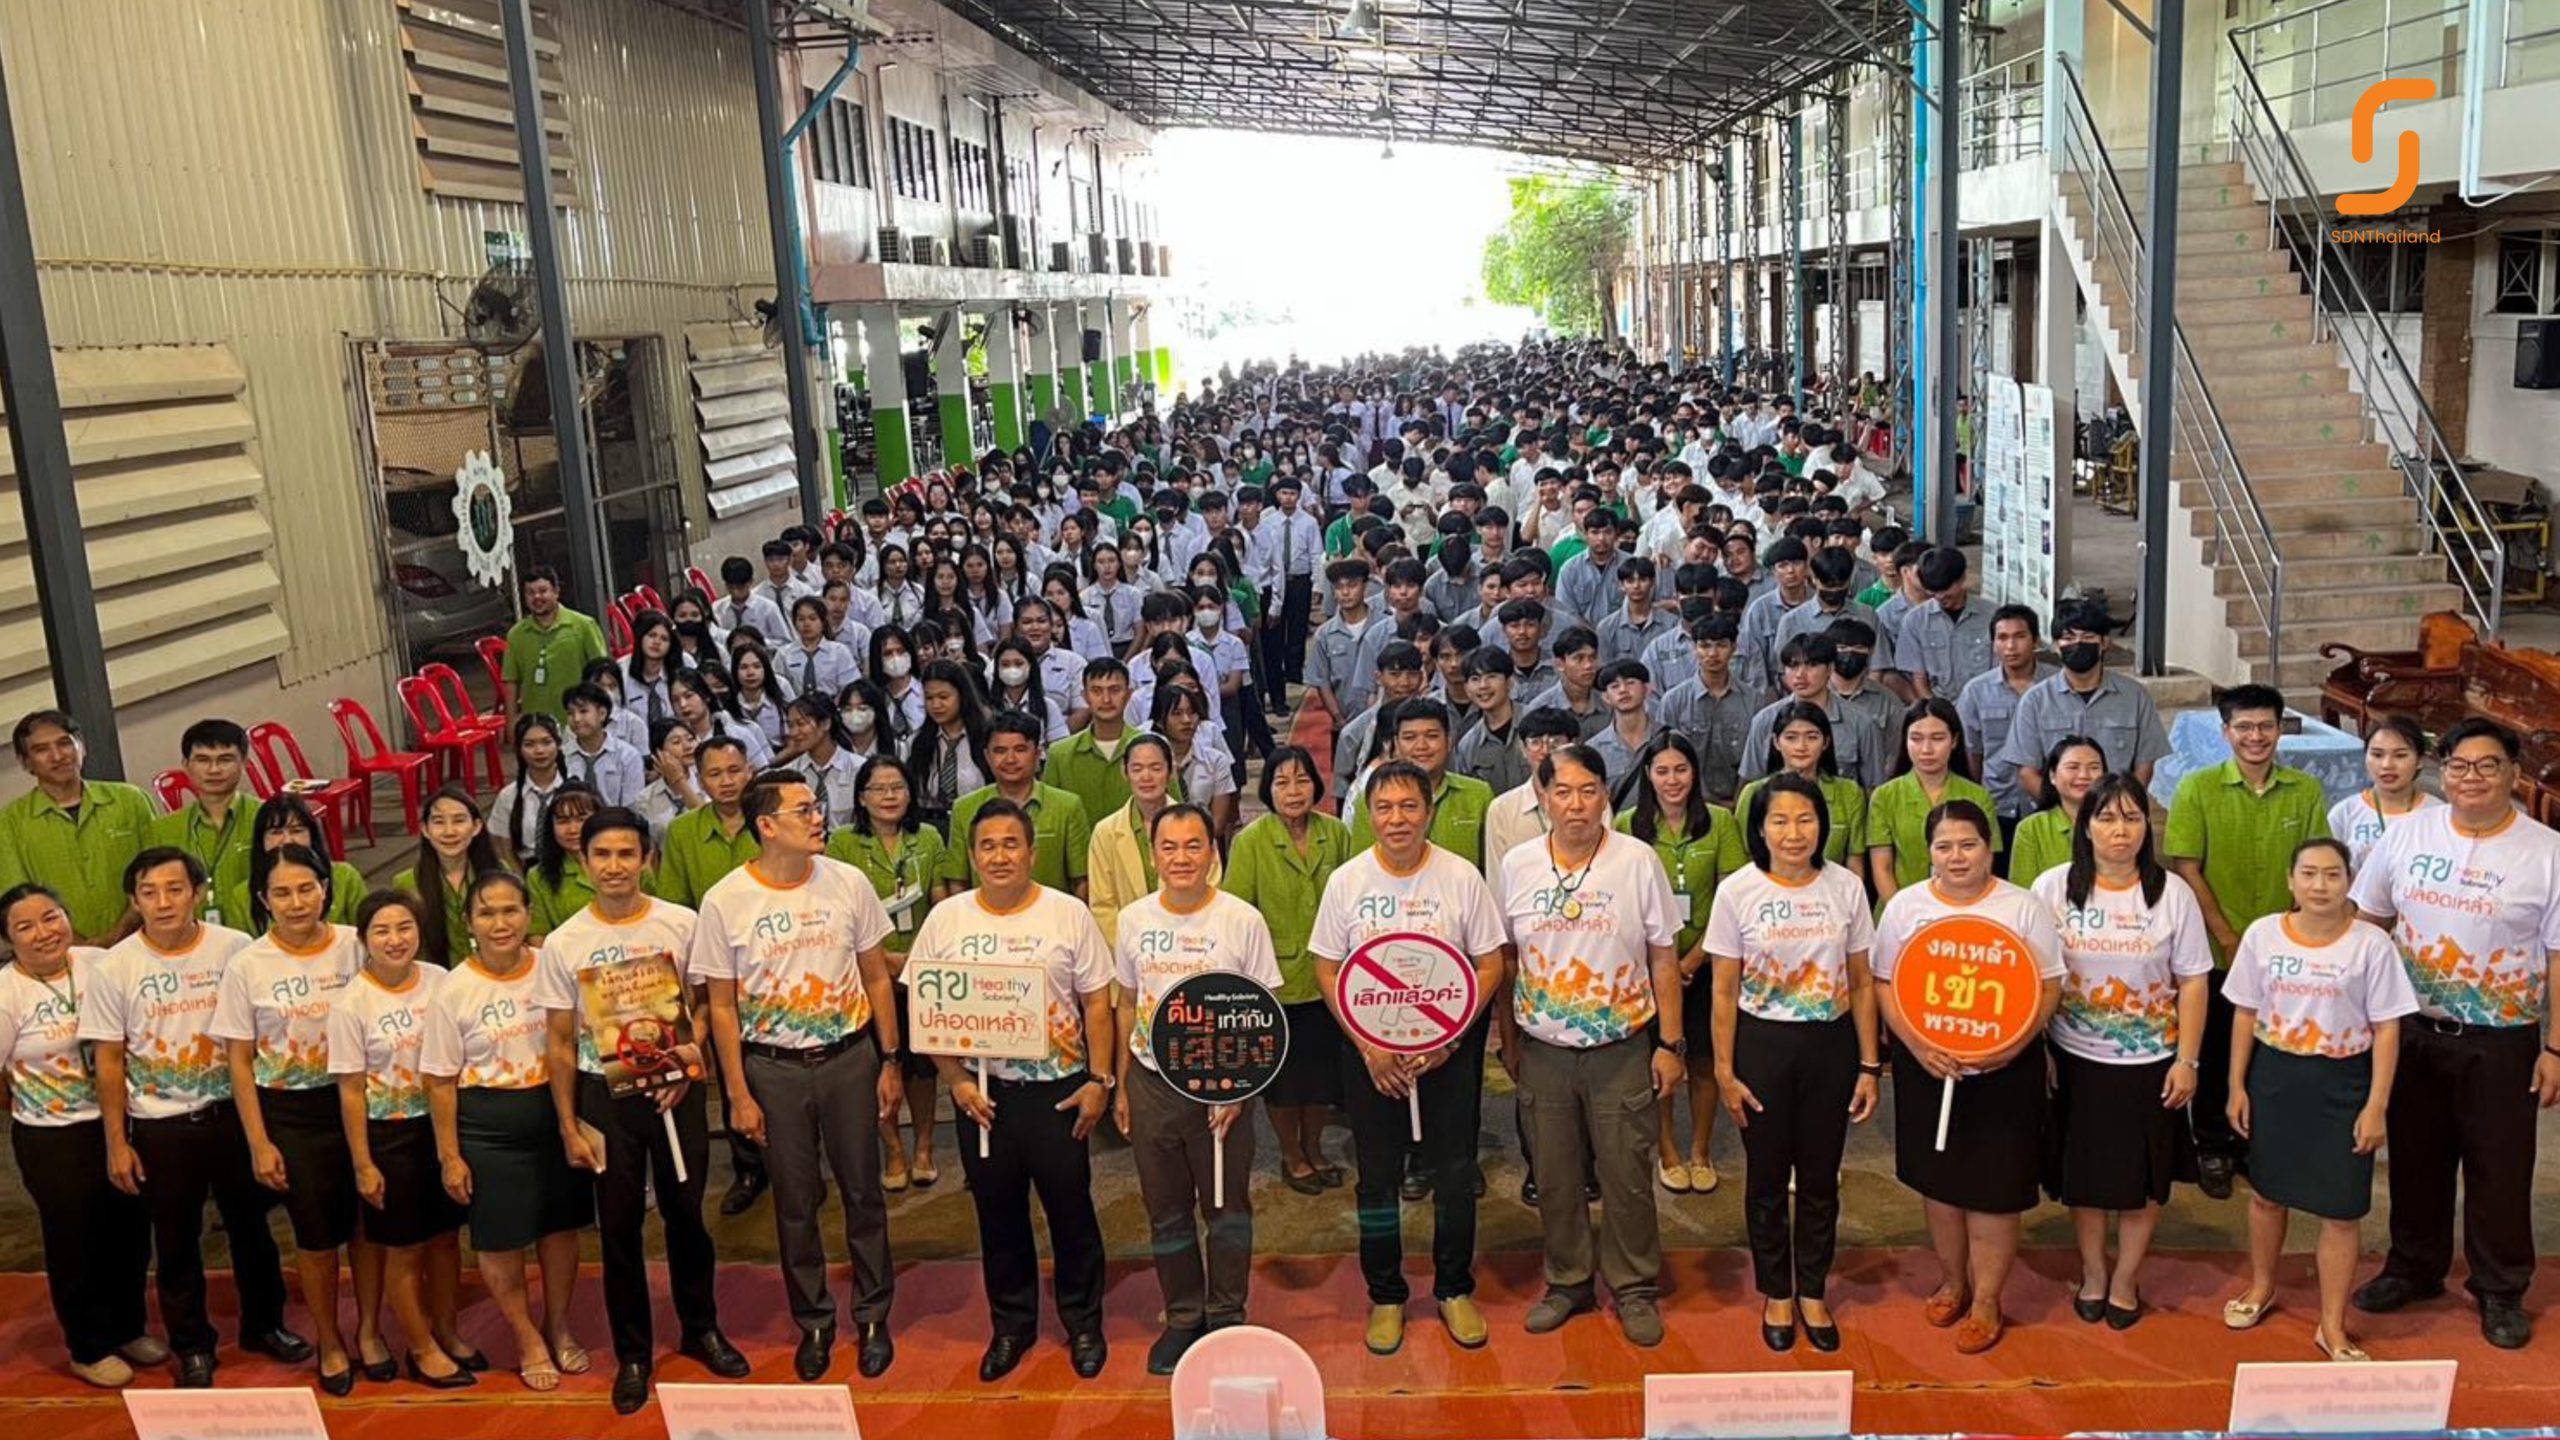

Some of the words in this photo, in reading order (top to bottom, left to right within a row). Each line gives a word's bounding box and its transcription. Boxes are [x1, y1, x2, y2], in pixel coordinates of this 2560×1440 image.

[2409, 854, 2454, 887] สุข
[1359, 895, 1396, 927] สุข
[1759, 900, 1792, 928] สุข
[2403, 885, 2494, 916] ปลอดเหล้า
[755, 911, 792, 943] สุข
[2066, 906, 2105, 937] สุข
[961, 933, 998, 961] สุข
[1140, 929, 1175, 959] สุข
[1926, 938, 2018, 967] งดเหล้า
[2268, 955, 2304, 981] สุข
[139, 971, 179, 1004] สุข
[272, 974, 310, 1004] สุข
[917, 969, 968, 1011] สุข
[972, 976, 1031, 997] Healthy
[982, 992, 1021, 1004] Sobriety
[1353, 981, 1464, 1007] เลิกแล้วค่ะ
[1924, 962, 2006, 1016] เข้า
[378, 1006, 413, 1037] สุข
[481, 997, 516, 1028] สุข
[919, 1007, 1027, 1032] ปลอดเหล้า
[1168, 991, 1203, 1025] ดื่ม
[1217, 1008, 1274, 1030] เท่ากับ
[1923, 1011, 2001, 1041] พรรษา
